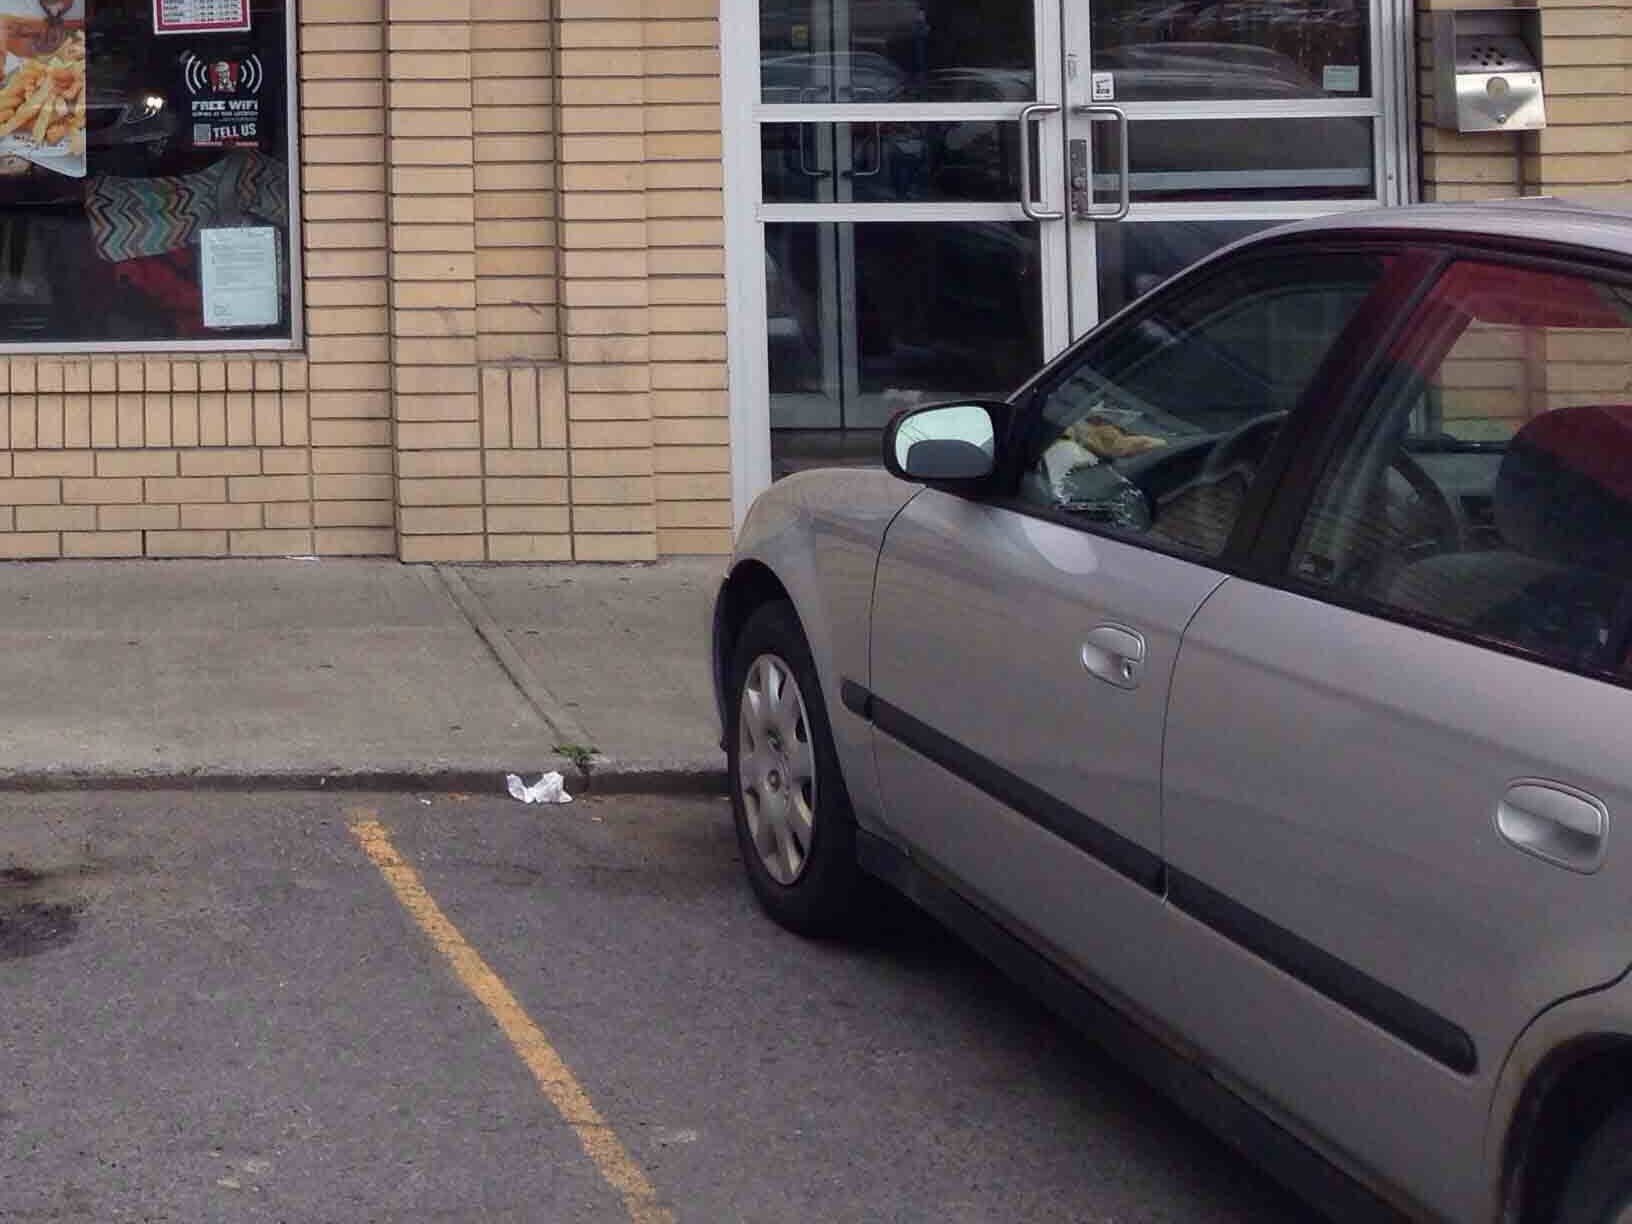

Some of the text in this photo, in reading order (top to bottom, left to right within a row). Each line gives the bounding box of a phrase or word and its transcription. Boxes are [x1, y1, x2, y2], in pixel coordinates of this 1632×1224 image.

[191, 100, 226, 111] FREE
[212, 122, 257, 138] TELL US
